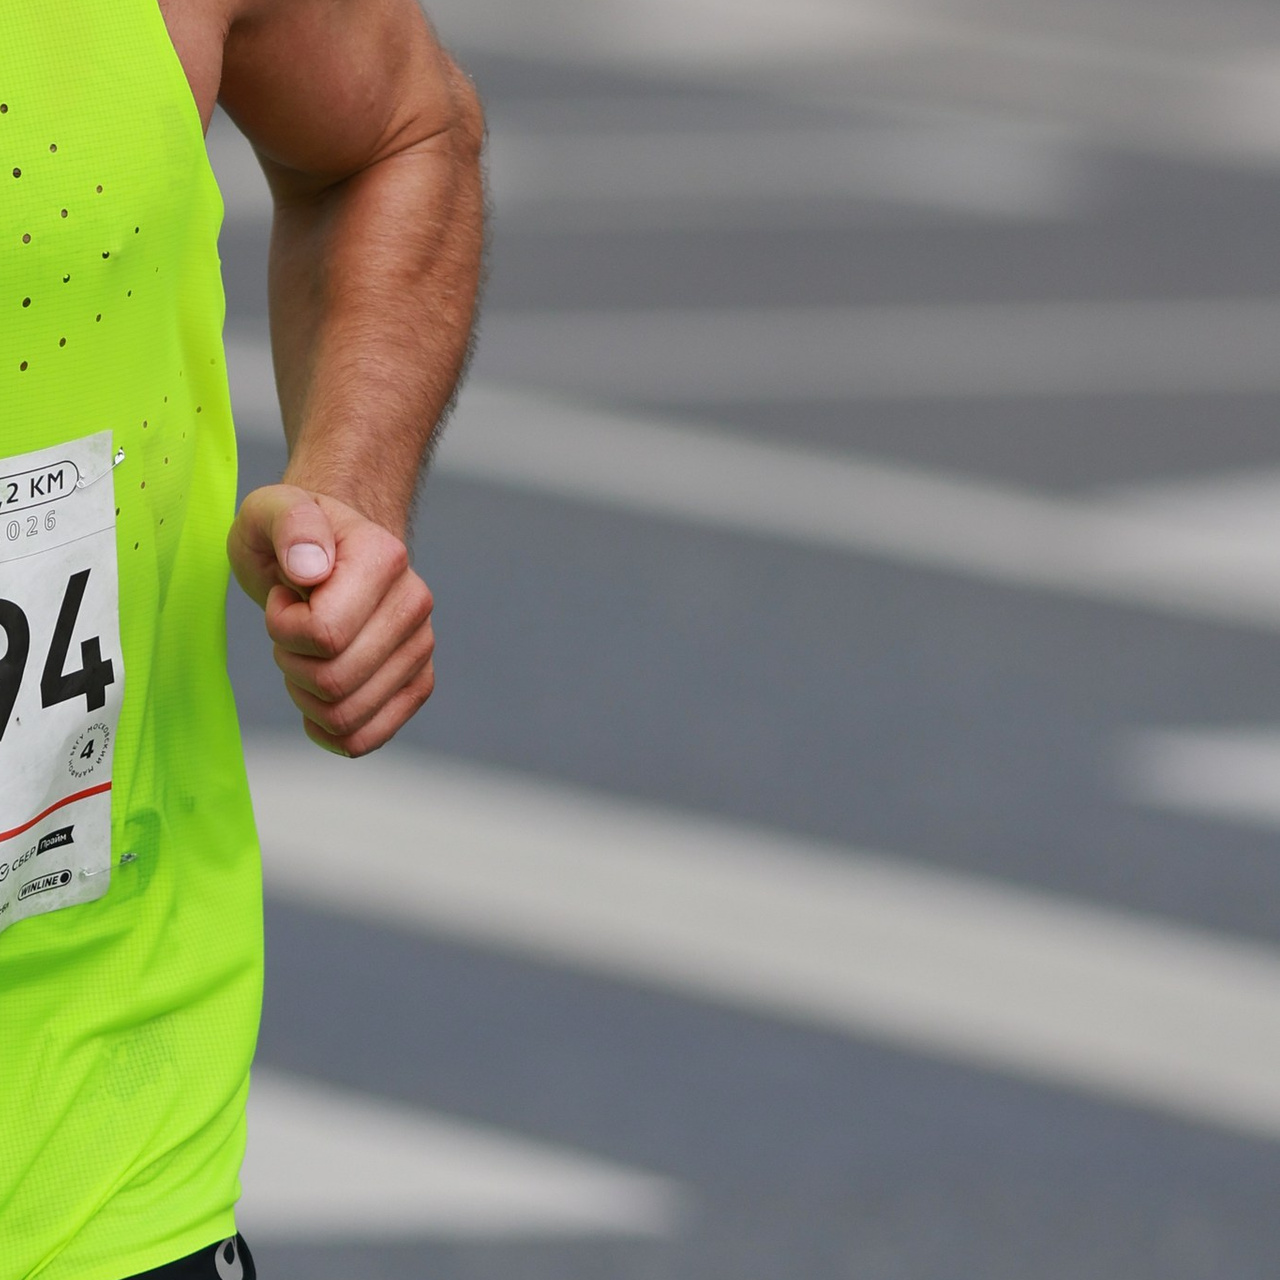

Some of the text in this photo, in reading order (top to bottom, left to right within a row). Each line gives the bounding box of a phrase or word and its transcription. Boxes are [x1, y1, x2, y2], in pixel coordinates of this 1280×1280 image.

[30, 469, 64, 499] КМ
[79, 738, 95, 759] 4
[11, 833, 67, 872] СБЕР Прайм
[20, 875, 59, 897] WINLINE
